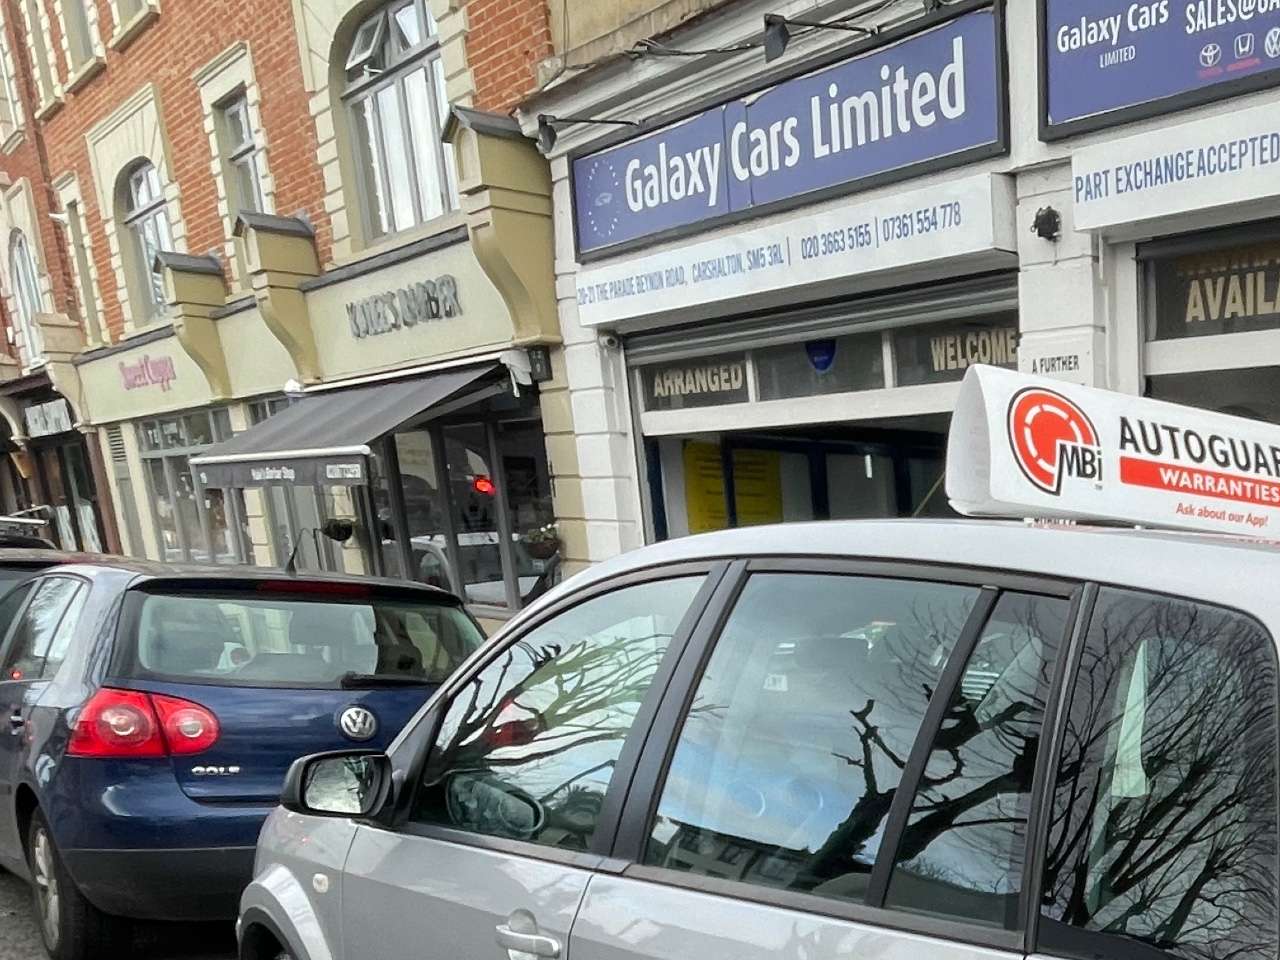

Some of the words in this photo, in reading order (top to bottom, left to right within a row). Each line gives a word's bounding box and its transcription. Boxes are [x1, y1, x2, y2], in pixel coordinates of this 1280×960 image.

[1056, 14, 1122, 53] Galaxy
[1127, 0, 1169, 33] Cars
[1099, 45, 1136, 69] LIMITED
[625, 142, 721, 213] Galaxy
[731, 116, 800, 182] Cars
[811, 35, 967, 160] Limited
[1075, 169, 1111, 204] PART
[1114, 149, 1194, 195] EXCHANGE
[1197, 131, 1280, 176] ACCEPTED
[595, 281, 609, 301] THE
[609, 276, 635, 300] PARADE
[691, 253, 746, 284] CARSHALTON,
[747, 247, 766, 271] SM5
[767, 243, 784, 265] 3RL
[801, 235, 819, 260] 020
[821, 229, 845, 255] 3663
[847, 223, 871, 250] 5155
[883, 212, 914, 242] 07361
[917, 208, 938, 234] 554
[941, 201, 962, 229] 778
[929, 326, 1019, 372] WELCOME
[1031, 358, 1038, 375] A
[1040, 354, 1080, 374] FURTHER
[653, 362, 743, 398] ARRANGED
[1159, 466, 1280, 503] WARRANTIES
[1176, 503, 1195, 516] Ask
[1200, 505, 1226, 522] about
[1228, 511, 1244, 523] our
[1246, 513, 1269, 528] App!
[191, 766, 240, 776] GOLF
